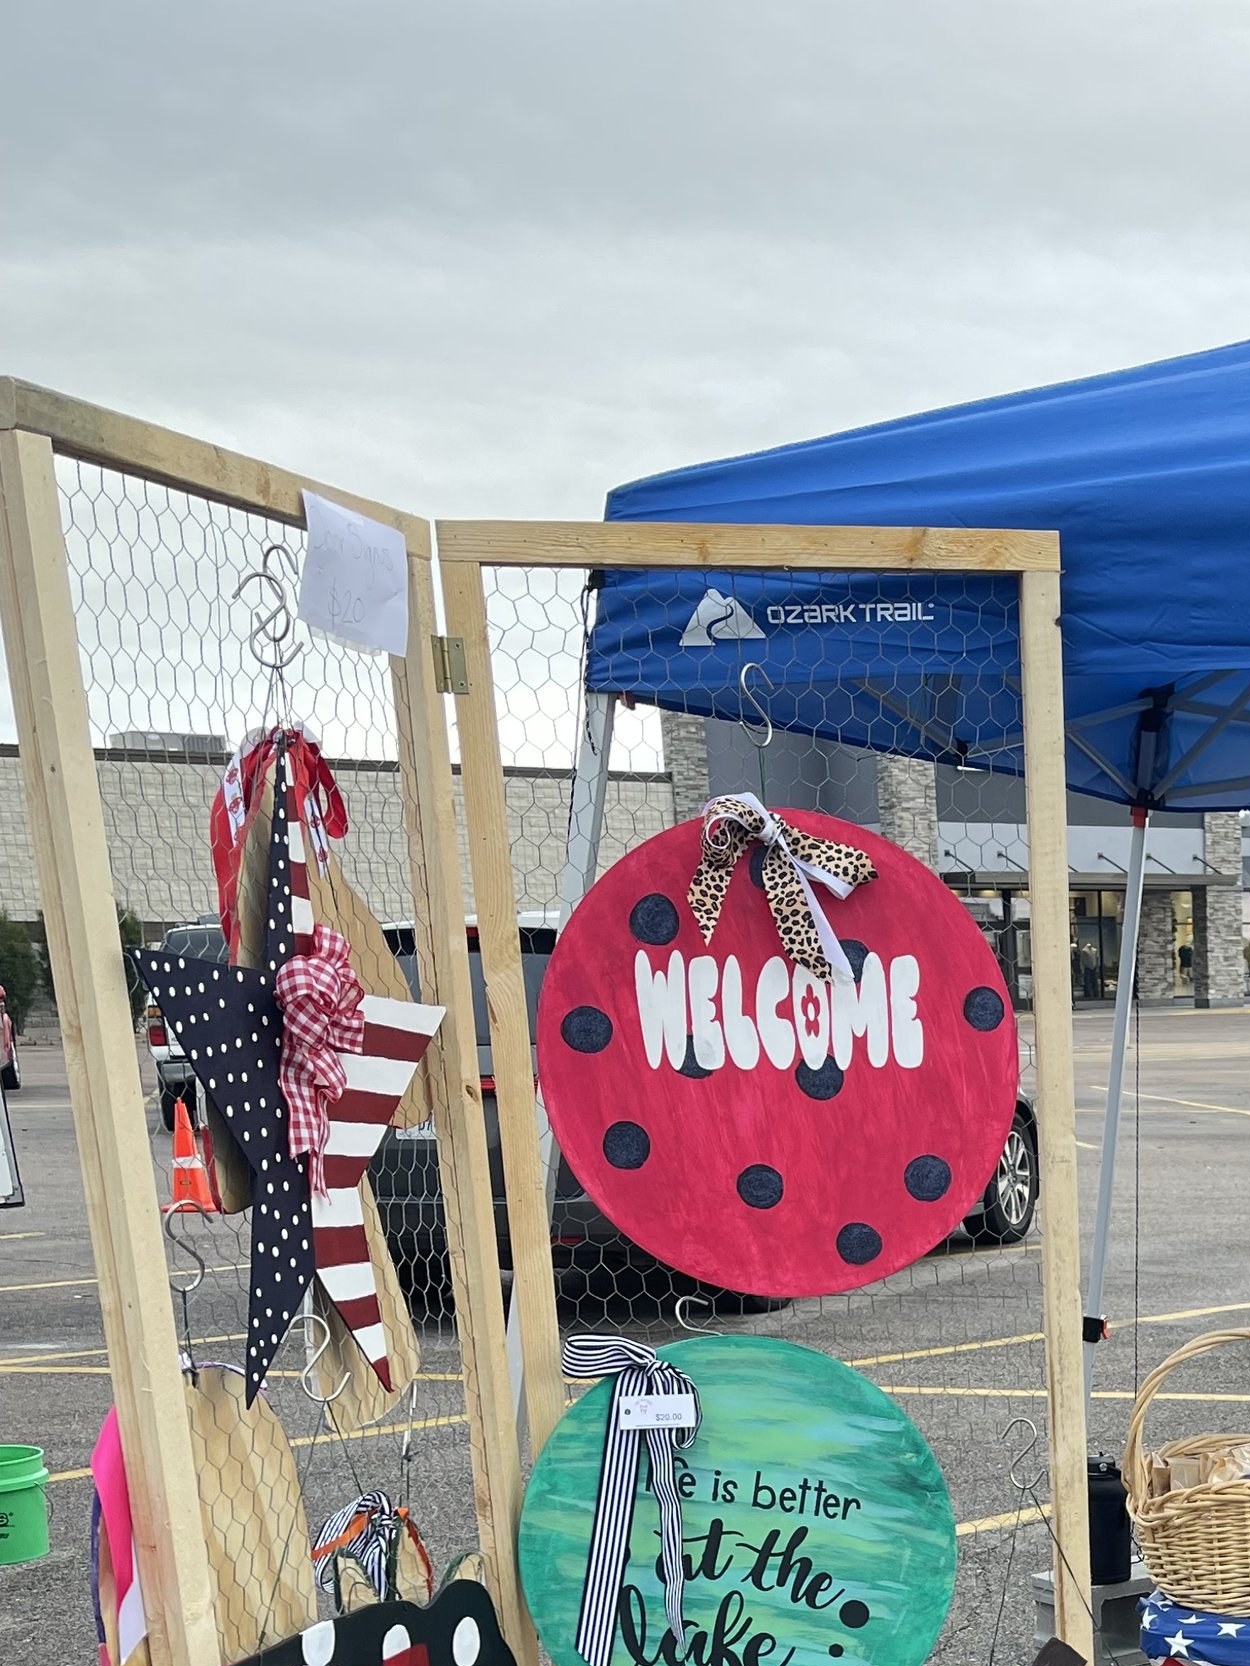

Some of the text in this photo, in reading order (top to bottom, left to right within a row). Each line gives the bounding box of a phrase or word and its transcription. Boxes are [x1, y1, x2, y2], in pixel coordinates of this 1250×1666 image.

[327, 576, 367, 631] $20
[634, 949, 924, 1070] WELCOME
[655, 1413, 682, 1421] $20.00
[712, 1469, 738, 1504] is
[752, 1470, 861, 1520] better
[734, 1525, 846, 1610] the
